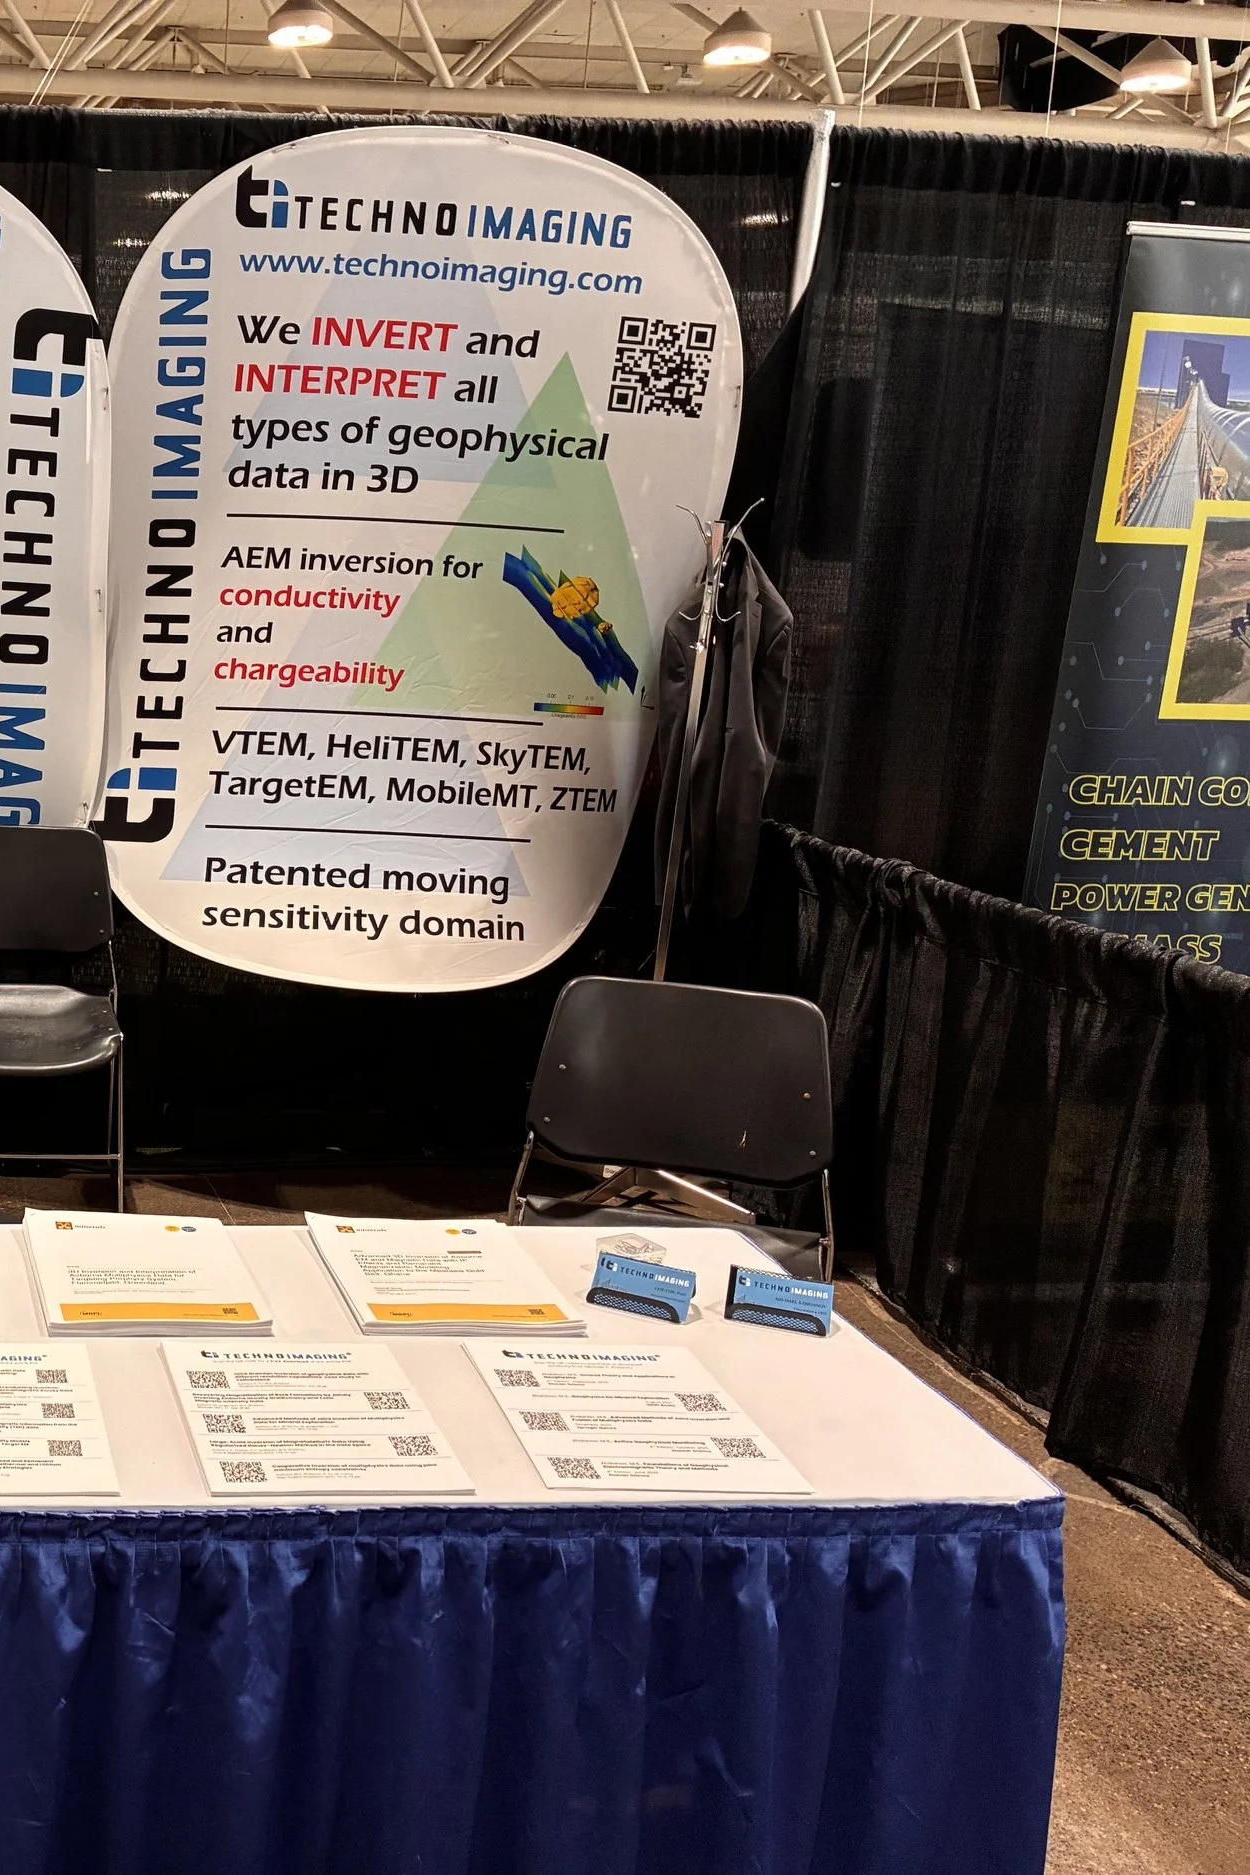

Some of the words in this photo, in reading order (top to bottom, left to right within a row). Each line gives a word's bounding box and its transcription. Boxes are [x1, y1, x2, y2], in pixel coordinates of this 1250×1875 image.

[295, 196, 633, 249] TECHNOIMAGING
[239, 252, 643, 295] www.technoimaging.com
[237, 314, 301, 345] We
[311, 316, 458, 353] INVERT
[465, 330, 540, 359] and
[234, 364, 446, 400] INTERPRET
[454, 375, 497, 404] all
[231, 414, 329, 449] types
[339, 416, 380, 445] of
[388, 424, 609, 463] geophysical
[227, 459, 311, 490] data
[321, 462, 355, 491] in
[365, 464, 419, 494] 3D
[132, 248, 211, 758] TECHNOIMAGING
[220, 546, 291, 570] AEM
[300, 550, 433, 576] inversion
[442, 554, 483, 579] for
[220, 584, 401, 618] conductivity
[216, 621, 273, 644] and
[213, 657, 405, 692] chargeability
[212, 730, 315, 760] VTEM,
[327, 735, 467, 768] HeliTEM,
[476, 741, 590, 775] SkyTEM,
[209, 771, 374, 805] TargetEM,
[387, 777, 542, 813] MobileMT,
[550, 788, 617, 813] ZTEM
[1069, 775, 1194, 806] CHAIN
[1198, 776, 1250, 806] CO
[1060, 829, 1220, 861] CEMENT
[204, 857, 371, 890] Patented
[382, 866, 509, 905] moving
[1051, 883, 1181, 911] POWER
[202, 905, 388, 940] sensitivity
[399, 909, 525, 941] domain
[620, 1266, 690, 1288] TECHNOIMAGING
[754, 1281, 829, 1299] TECHNOIMAGING
[223, 1351, 352, 1360] TECHNOIMAGING
[526, 1352, 660, 1362] TECHNOIMAGING
